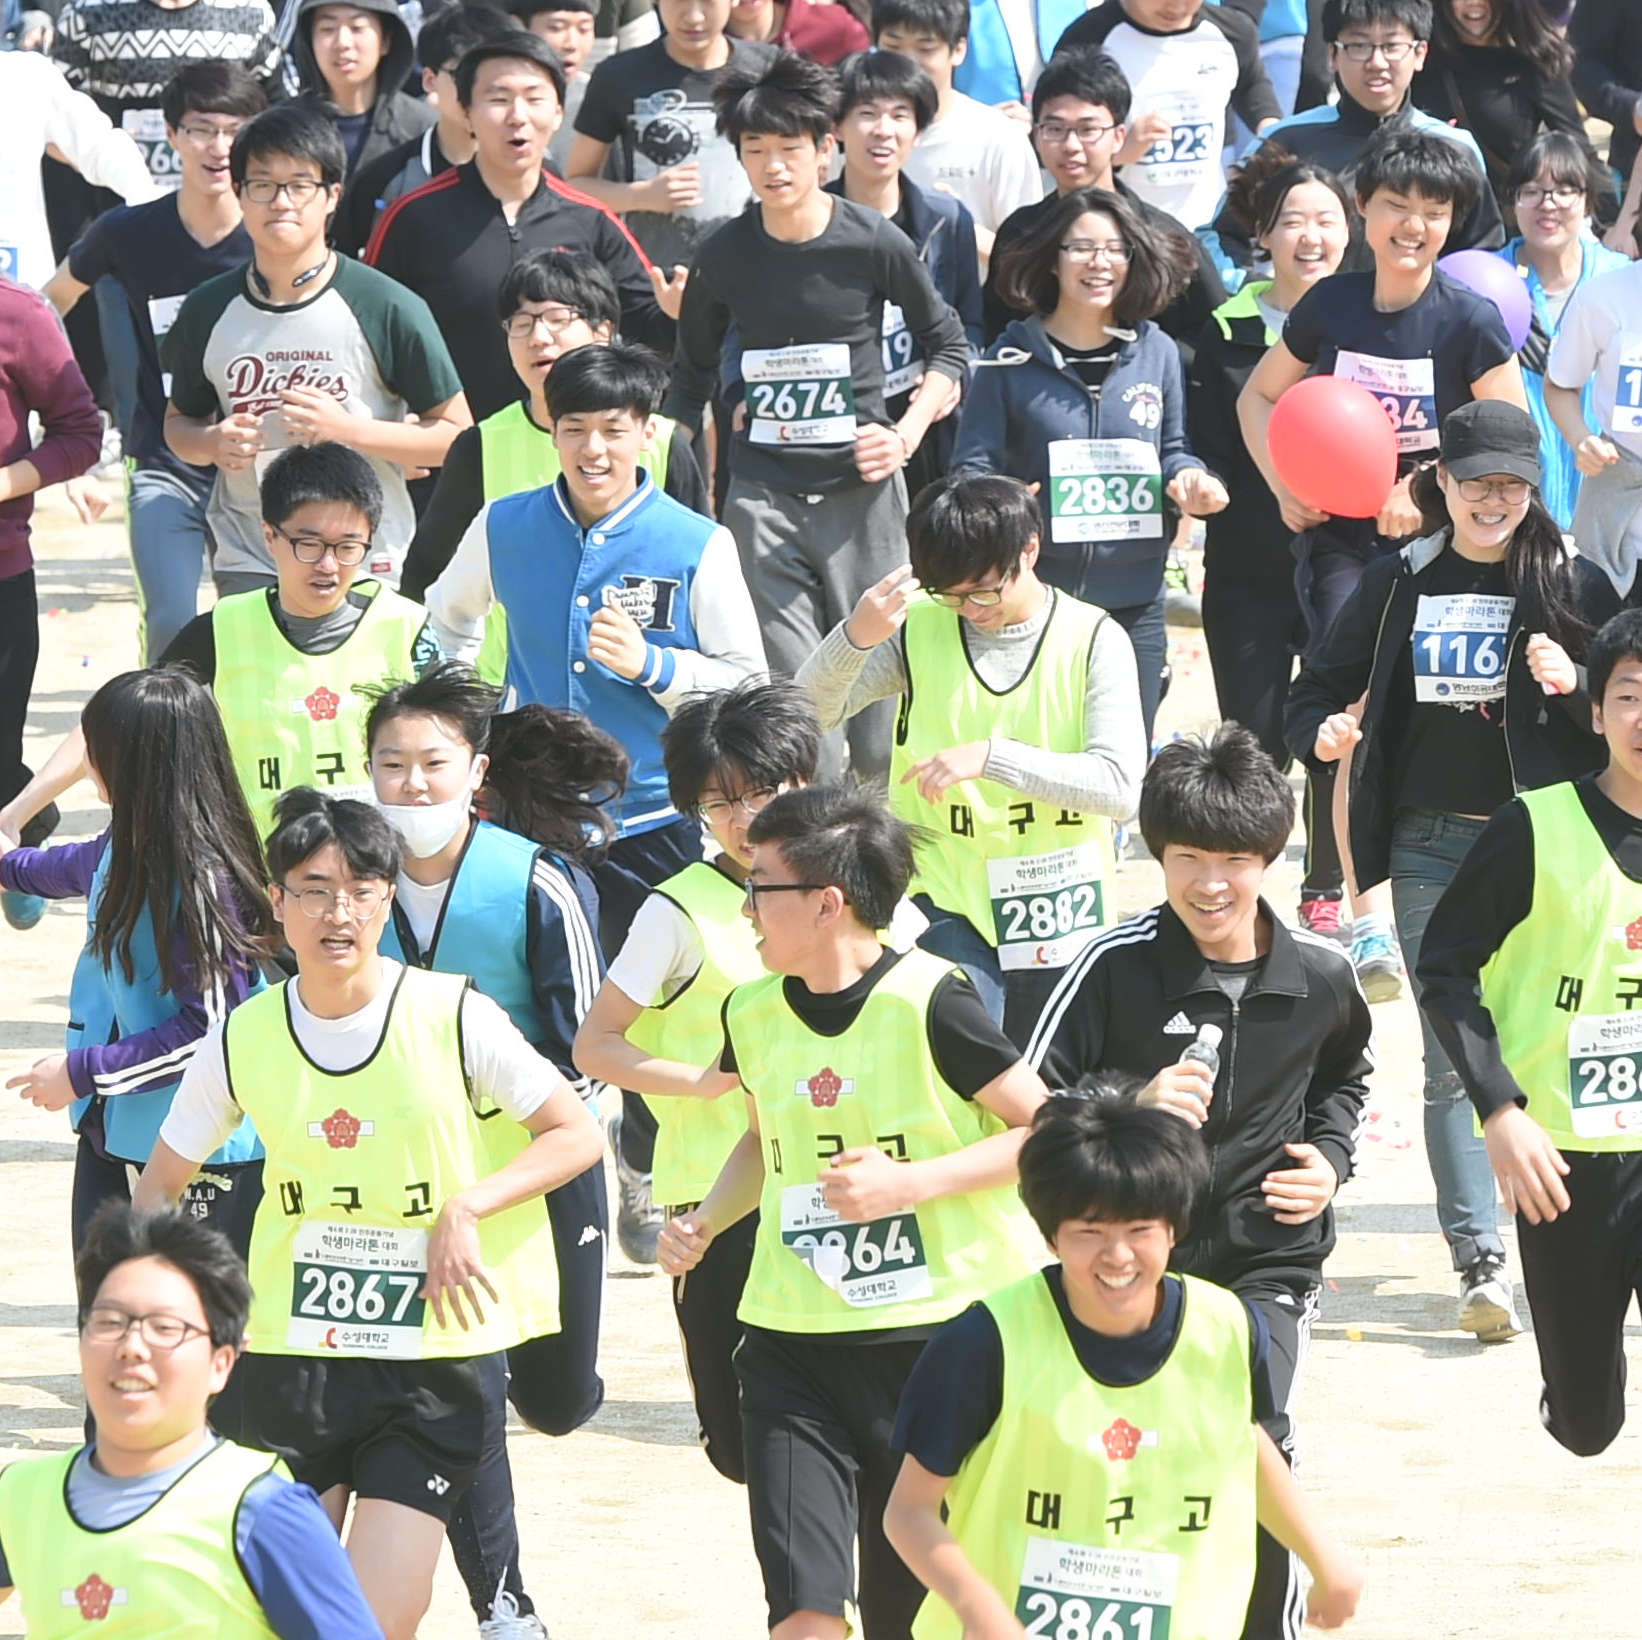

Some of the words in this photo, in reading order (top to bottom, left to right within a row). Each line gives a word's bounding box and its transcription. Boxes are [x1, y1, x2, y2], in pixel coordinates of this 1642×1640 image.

[265, 350, 334, 362] ORIGINAL
[226, 355, 349, 402] Dickies
[752, 381, 847, 420] 2674
[1059, 476, 1155, 516] 2836
[1422, 634, 1507, 676] 116
[1000, 885, 1099, 941] 2882
[321, 1233, 380, 1251] 학생마라톤
[381, 1240, 399, 1251] 대회
[298, 1267, 419, 1322] 2867
[847, 1279, 898, 1298] 수성대학교
[341, 1331, 390, 1344] 수성대학교
[1059, 1557, 1123, 1576] 학생마라톤
[1024, 1593, 1156, 1640] 2861
